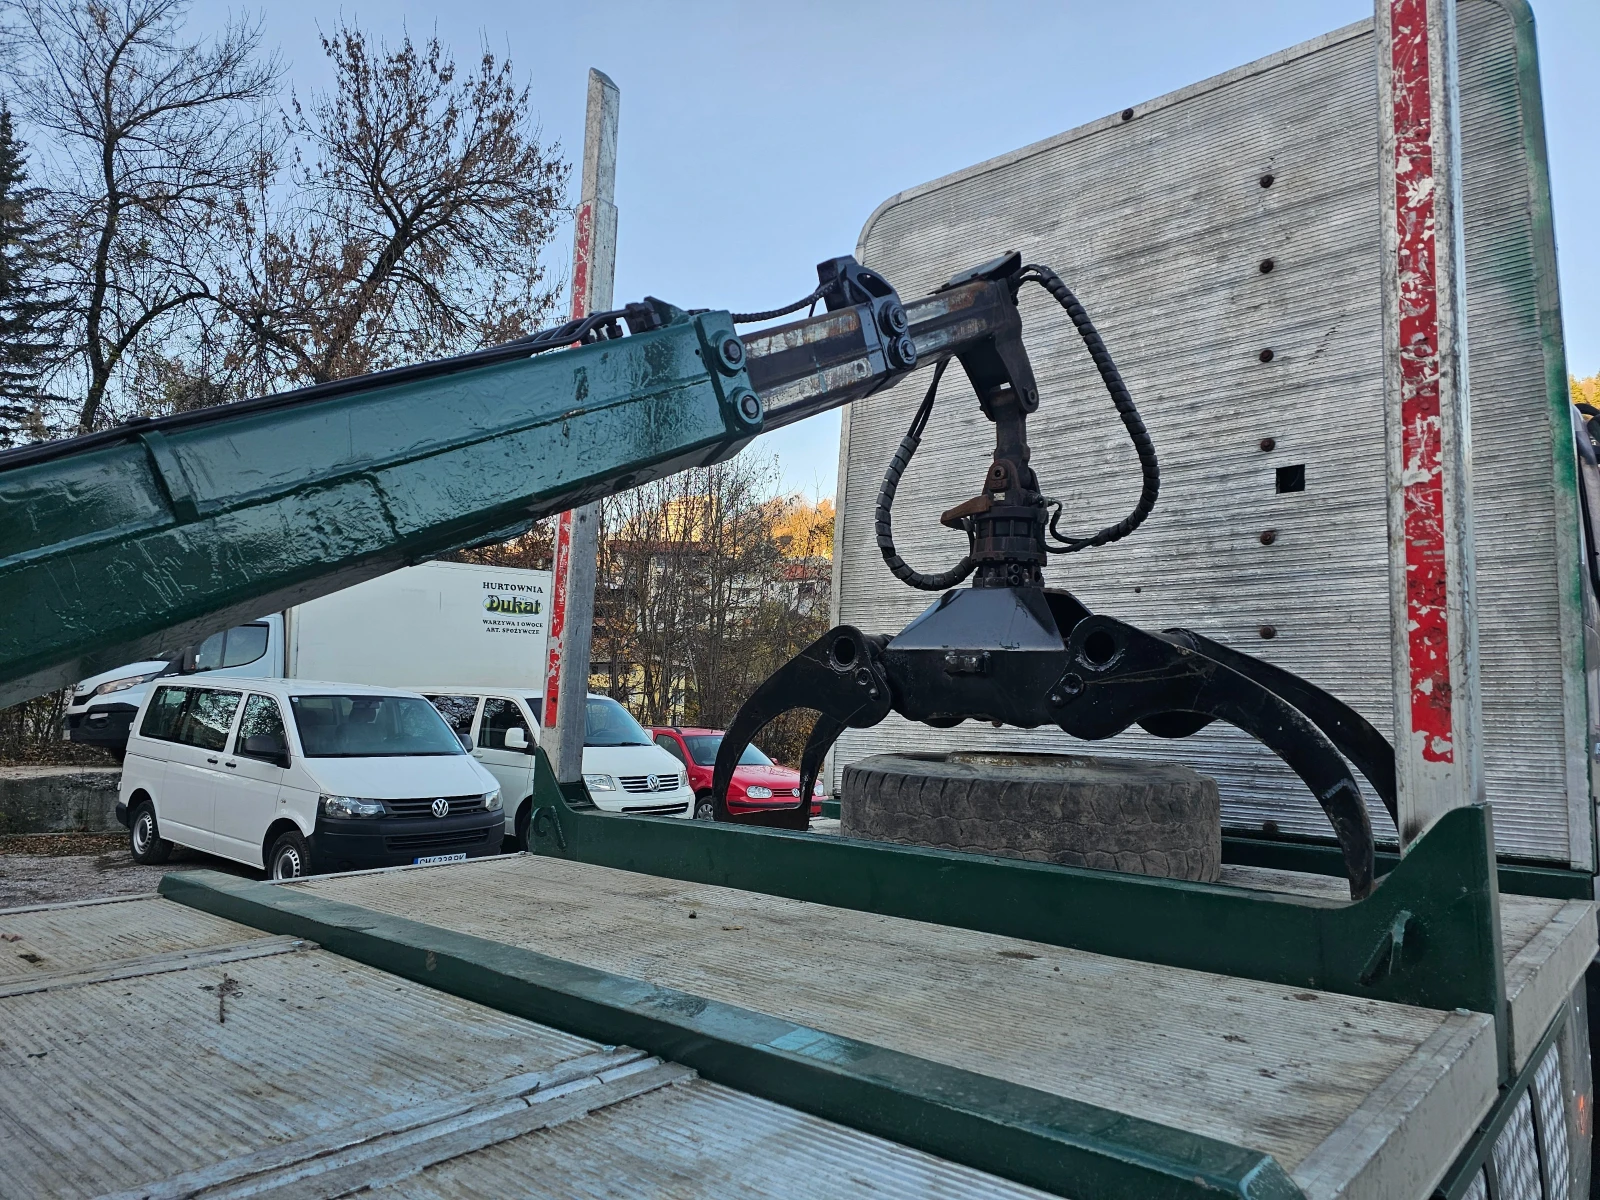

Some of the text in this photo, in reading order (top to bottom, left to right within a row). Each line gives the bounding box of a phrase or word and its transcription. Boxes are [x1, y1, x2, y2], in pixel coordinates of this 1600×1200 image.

[482, 581, 544, 594] HURTOWNIA
[486, 594, 541, 615] Dukat
[482, 619, 516, 627] WARZYWA
[501, 627, 540, 635] SPOŻYWCZE
